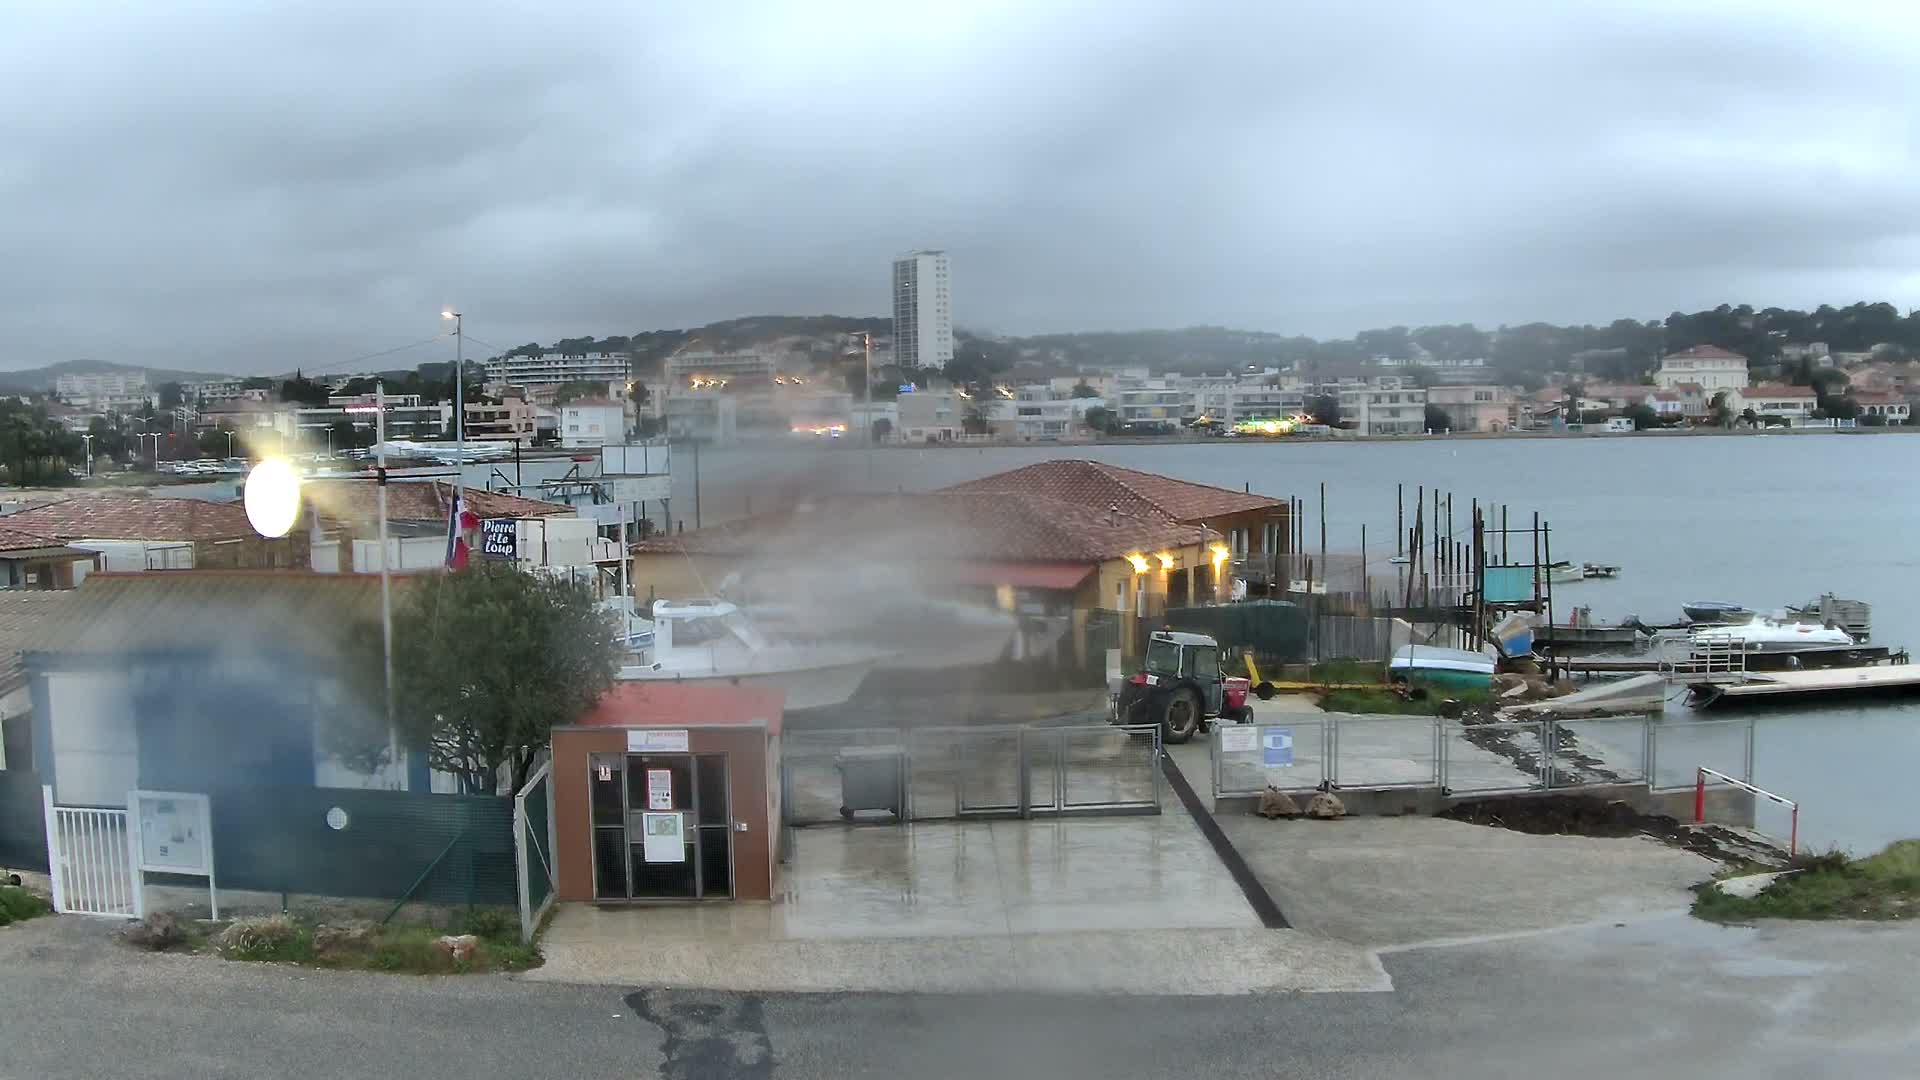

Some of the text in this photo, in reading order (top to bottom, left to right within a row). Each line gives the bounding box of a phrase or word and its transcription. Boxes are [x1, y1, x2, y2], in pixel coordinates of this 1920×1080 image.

[483, 520, 515, 533] Pierre
[488, 532, 496, 541] et
[485, 541, 513, 556] Loup
